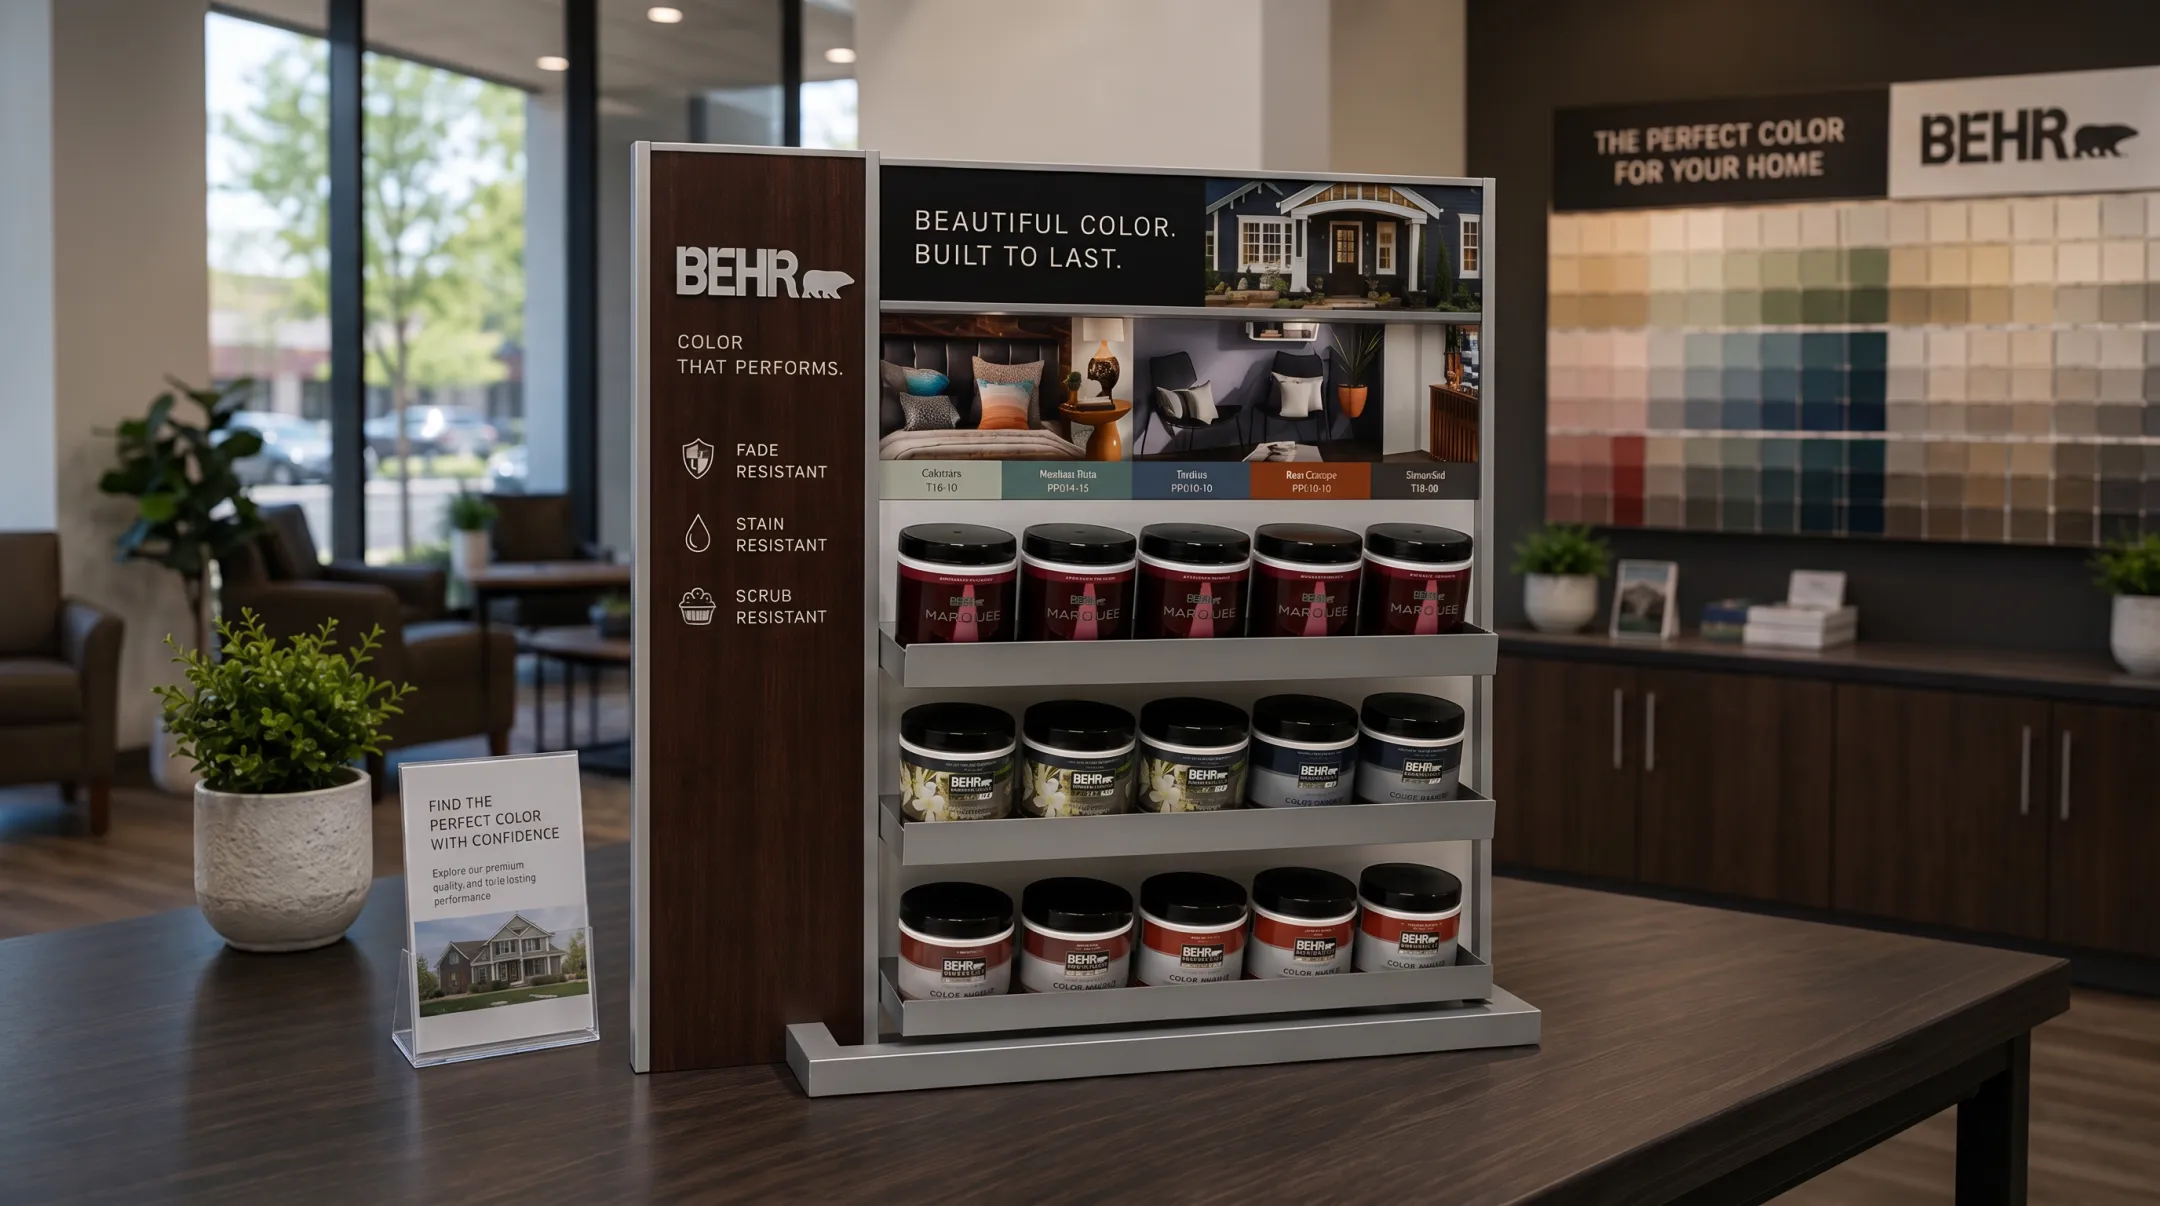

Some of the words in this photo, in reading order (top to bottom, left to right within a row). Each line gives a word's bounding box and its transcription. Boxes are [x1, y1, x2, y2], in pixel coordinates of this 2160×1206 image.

[1594, 128, 1640, 155] THE
[1646, 122, 1752, 153] PERFECT
[1758, 116, 1845, 147] COLOR
[1920, 106, 2069, 167] BEHR
[1614, 158, 1664, 186] FOR
[1670, 154, 1740, 183] YOUR
[1746, 150, 1824, 180] HOME
[915, 209, 1068, 234] BEAUTIFUL
[1080, 214, 1176, 237] COLOR.
[915, 243, 992, 266] BUILT
[1003, 245, 1037, 267] TO
[1050, 246, 1121, 269] LAST.
[676, 246, 800, 298] BEHR
[677, 334, 743, 350] COLOR
[677, 359, 727, 374] THAT
[736, 360, 843, 376] PERFORMS.
[736, 443, 778, 457] FADE
[736, 465, 827, 479] RESISTANT
[926, 482, 958, 492] T16-10
[1410, 483, 1439, 493] T18-00
[736, 517, 784, 531] STAIN
[736, 538, 827, 552] RESISTANT
[736, 589, 792, 603] SCRUB
[736, 610, 827, 625] RESISTANT
[1188, 769, 1218, 780] BEHR
[1301, 765, 1328, 776] BEHR
[951, 776, 981, 788] BEHR
[1073, 773, 1102, 785] BEHR
[428, 798, 462, 813] FIND
[465, 795, 492, 810] THE
[430, 814, 491, 832] PERFECT
[495, 810, 542, 826] COLOR
[430, 835, 467, 851] WITH
[472, 827, 560, 847] CONFIDENCE
[432, 867, 466, 879] Explore
[468, 866, 483, 874] our
[485, 862, 524, 874] premium
[466, 878, 483, 889] and
[434, 892, 491, 908] performance
[1296, 940, 1324, 951] BEHR
[1402, 933, 1429, 944] BEHR
[1183, 946, 1212, 957] BEHR
[944, 960, 973, 971] BEHR
[1067, 954, 1097, 965] BEHR
